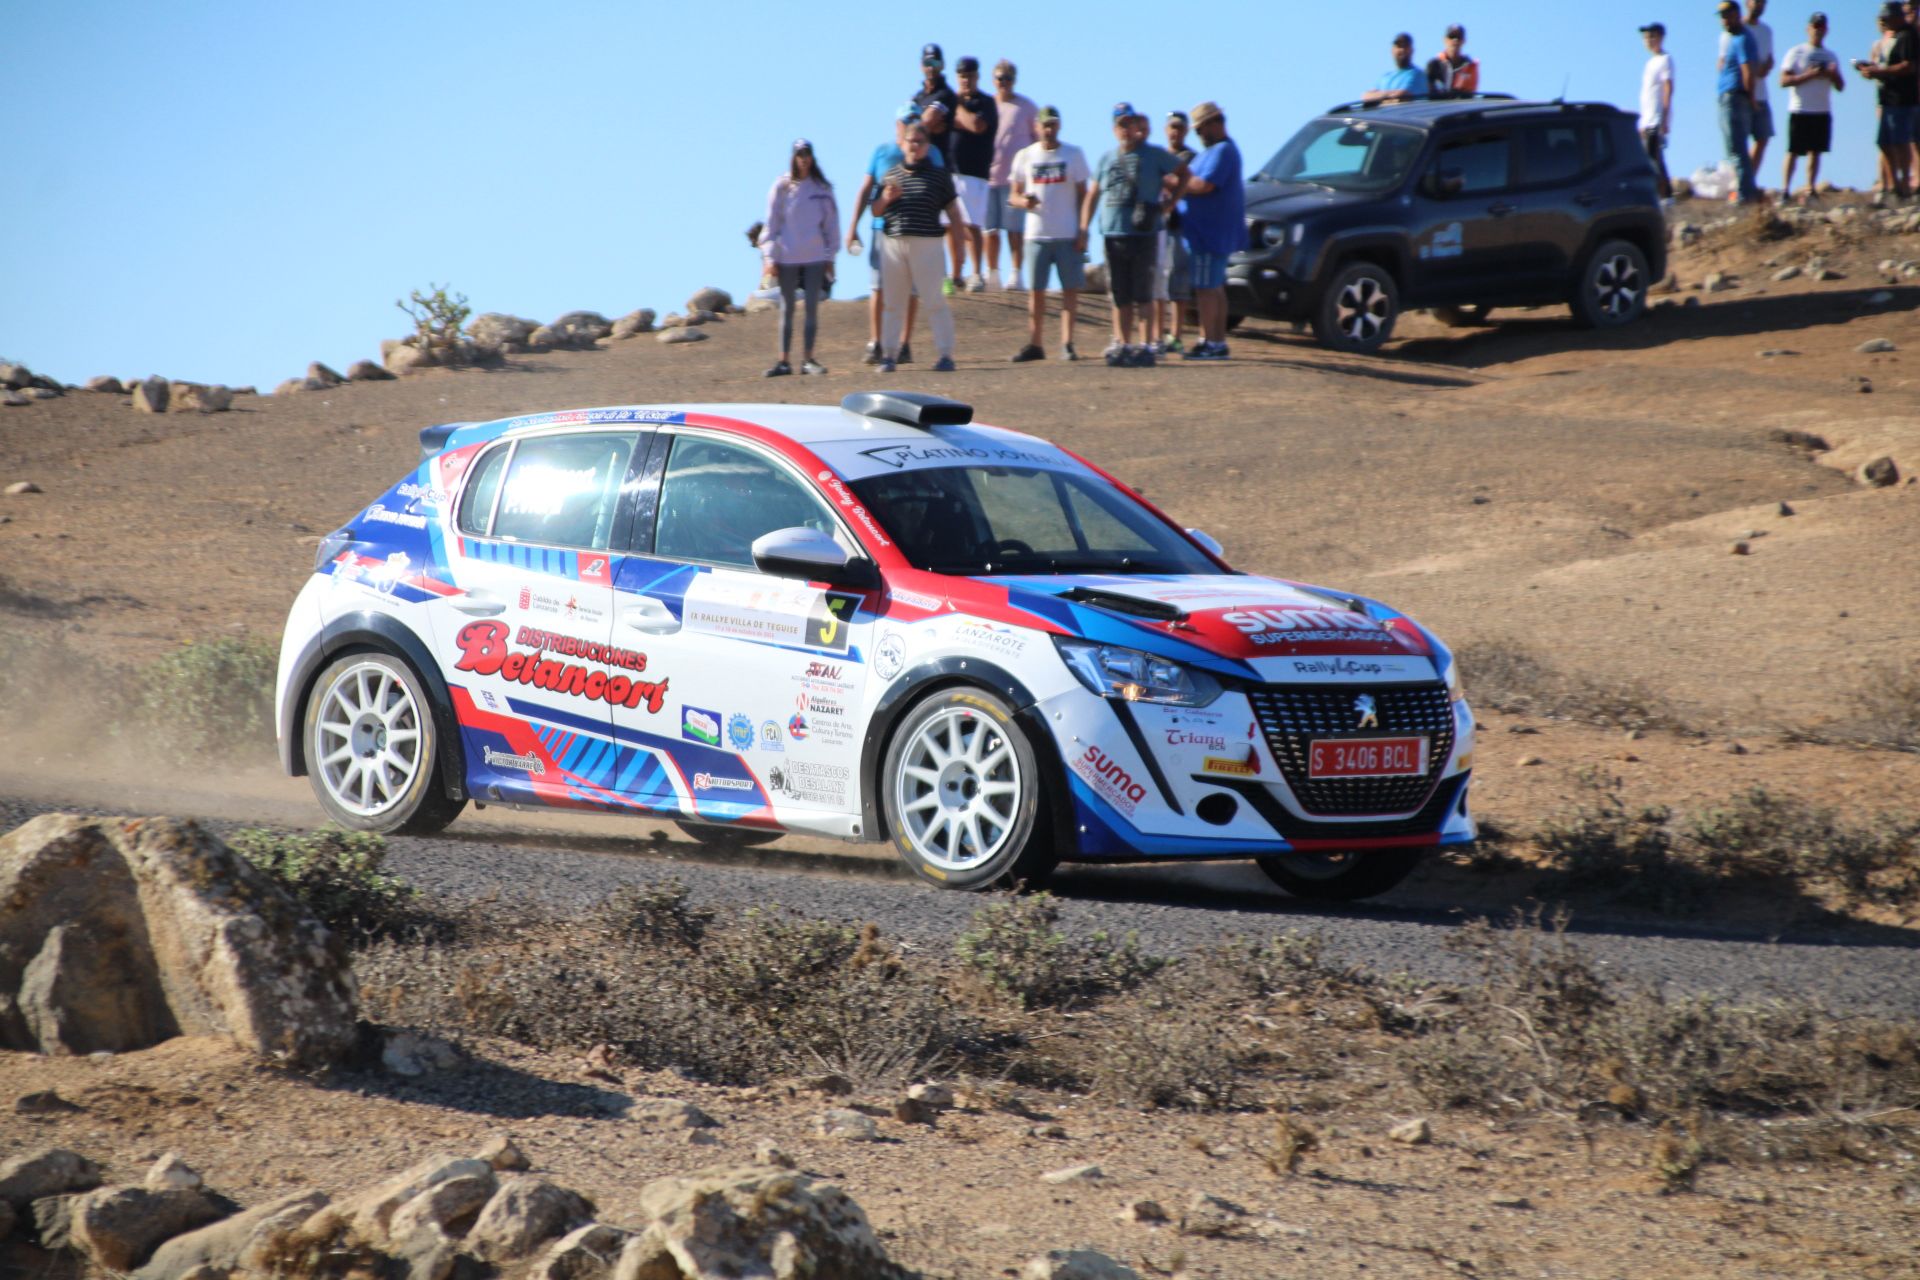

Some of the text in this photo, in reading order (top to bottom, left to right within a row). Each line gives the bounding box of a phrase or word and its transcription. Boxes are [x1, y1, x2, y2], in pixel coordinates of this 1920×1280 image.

[896, 447, 988, 462] PLATINO
[690, 611, 799, 634] IX RALLYE VILLA DE TEGUISE
[820, 599, 846, 644] 5
[1222, 608, 1382, 632] suma
[515, 625, 648, 672] DISTRIBUCIONES
[955, 626, 1026, 651] LANZAROTE
[1250, 630, 1393, 645] SUPERMERCADOS
[454, 618, 669, 714] Betancort
[810, 703, 845, 716] NAZARET
[765, 727, 778, 742] FCA
[1165, 729, 1225, 745] Triana
[1314, 745, 1413, 771] S 3406 BCL
[792, 760, 849, 780] DESATASCOS
[1083, 745, 1147, 804] suma
